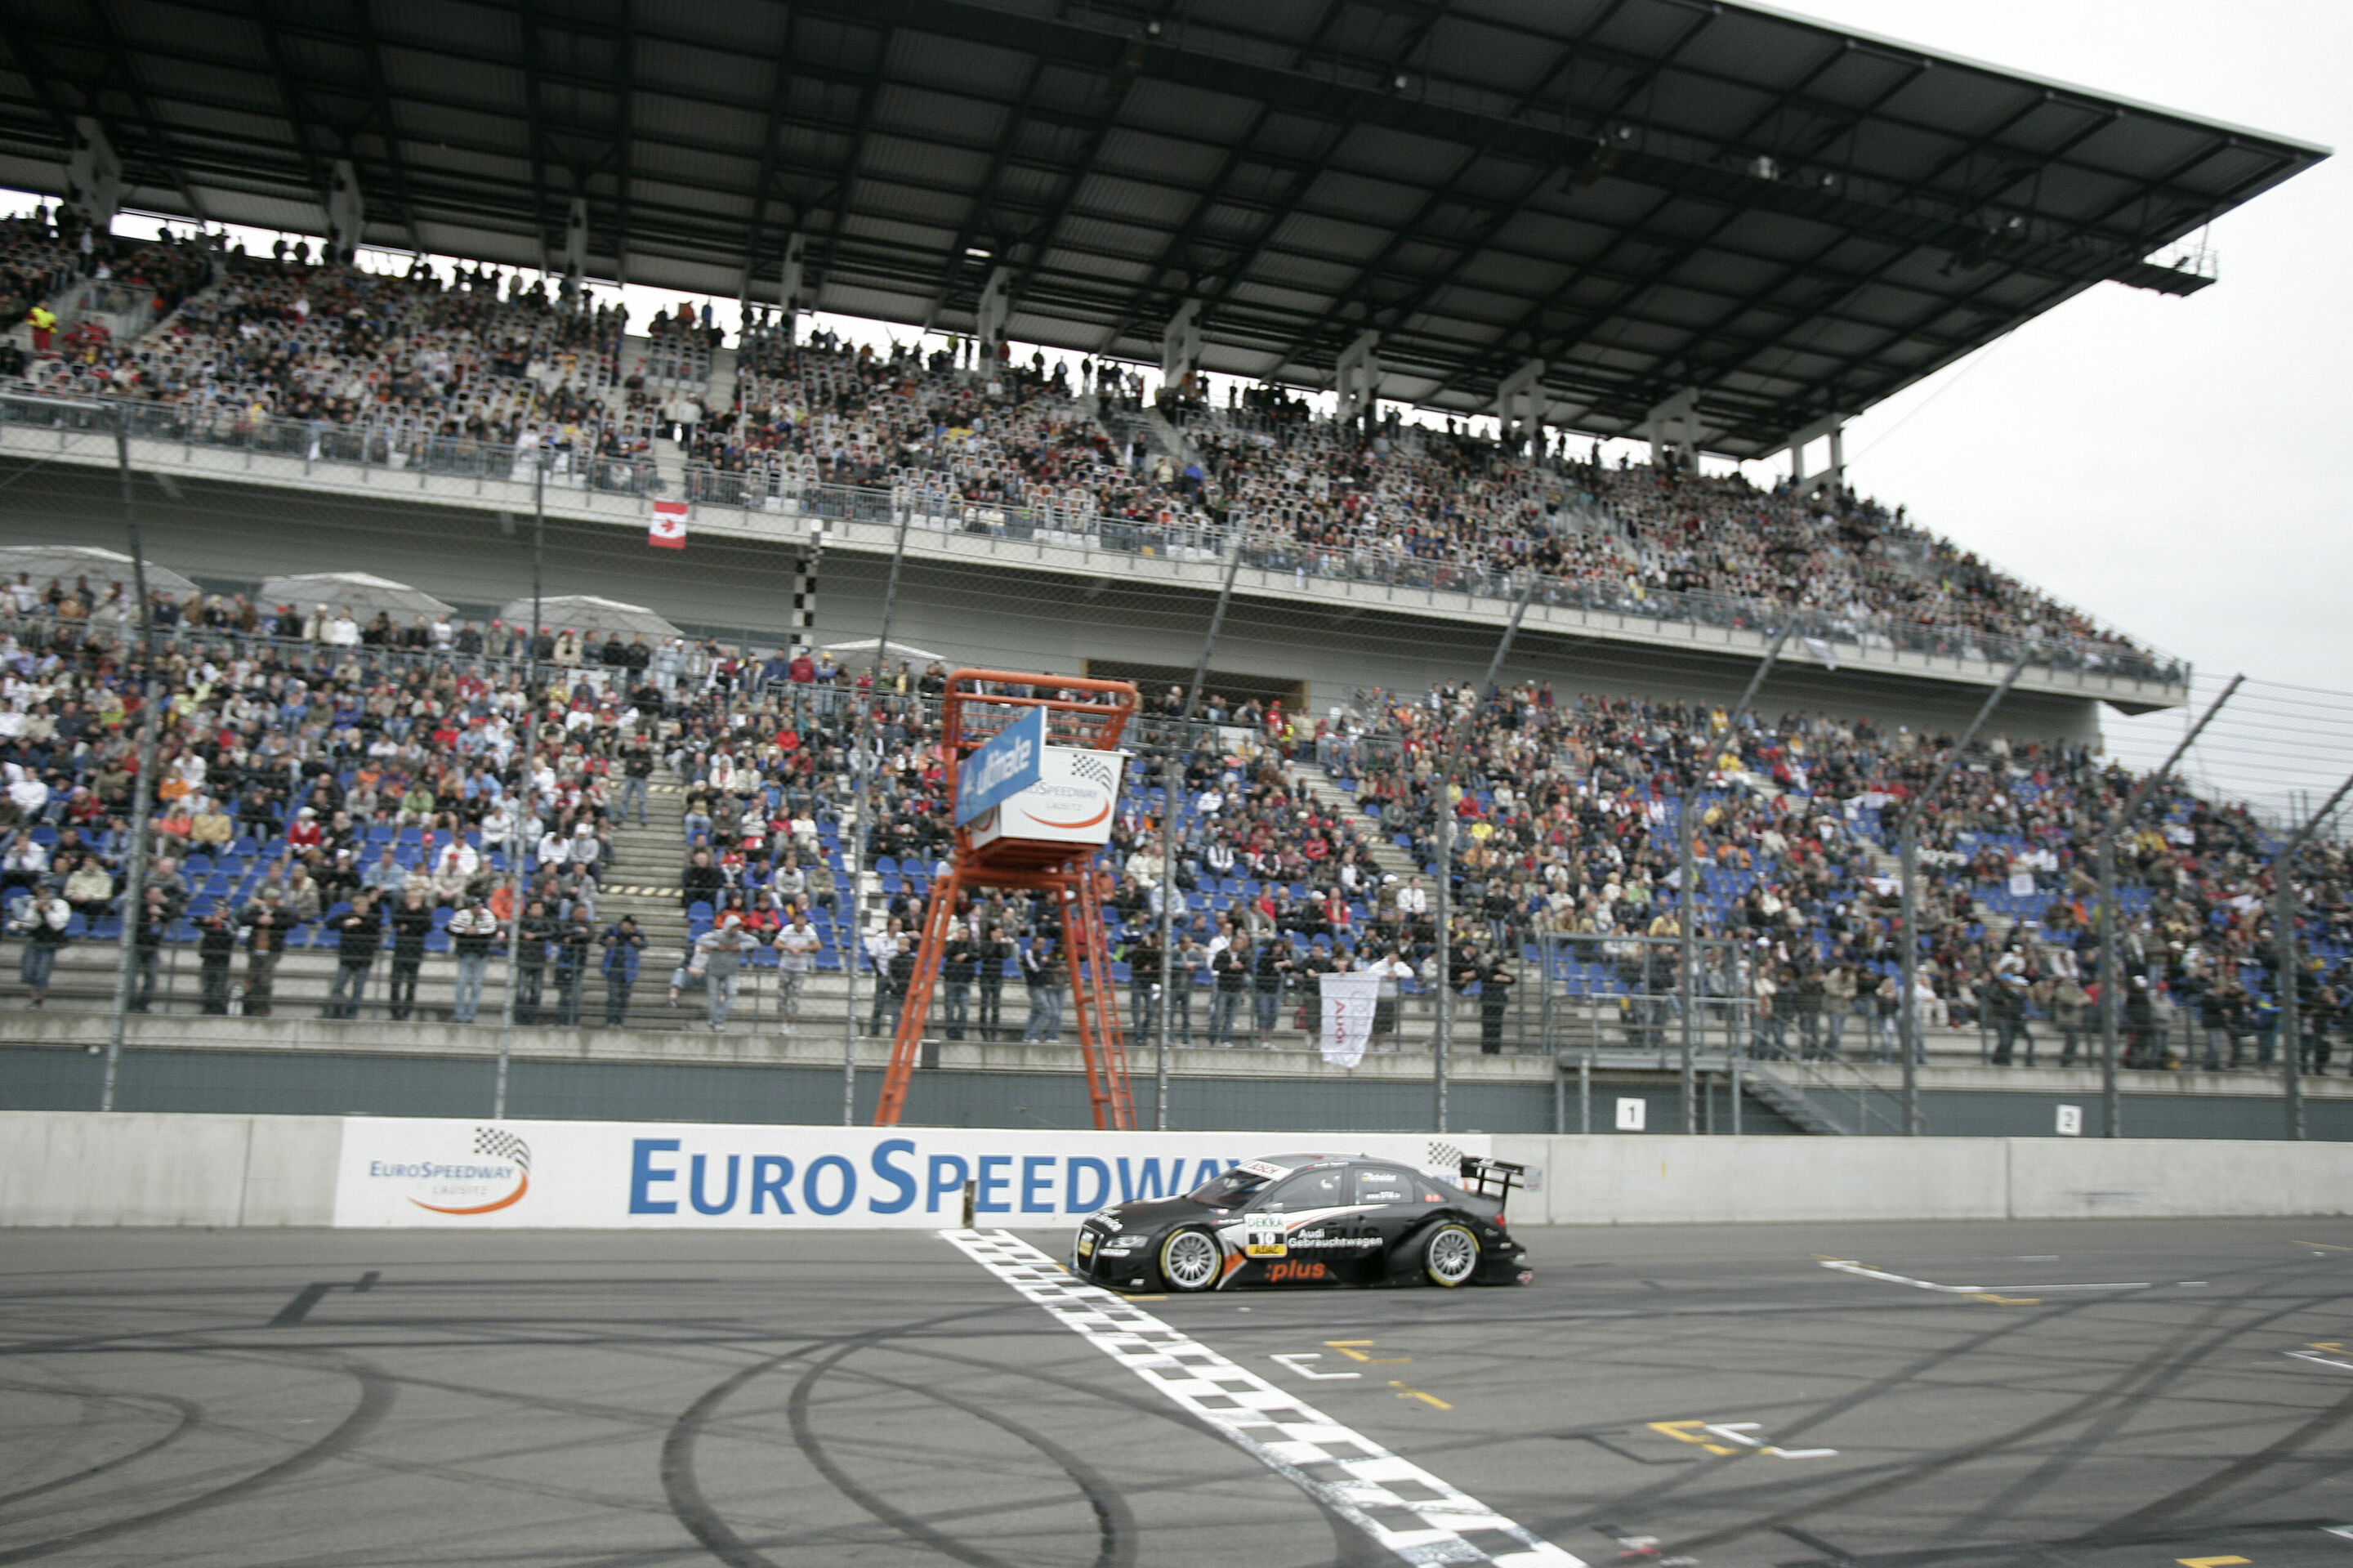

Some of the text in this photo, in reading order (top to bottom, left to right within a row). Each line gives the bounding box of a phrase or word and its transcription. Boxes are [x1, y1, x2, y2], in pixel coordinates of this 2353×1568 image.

[1627, 1105, 1634, 1123] 1
[2064, 1111, 2073, 1127] 2
[628, 1138, 1241, 1216] EUROSPEEDWA
[1248, 1217, 1284, 1227] DEKRA
[1257, 1232, 1276, 1245] 10
[1297, 1228, 1325, 1239] Audi
[1288, 1235, 1383, 1249] Gebrauchtwagen
